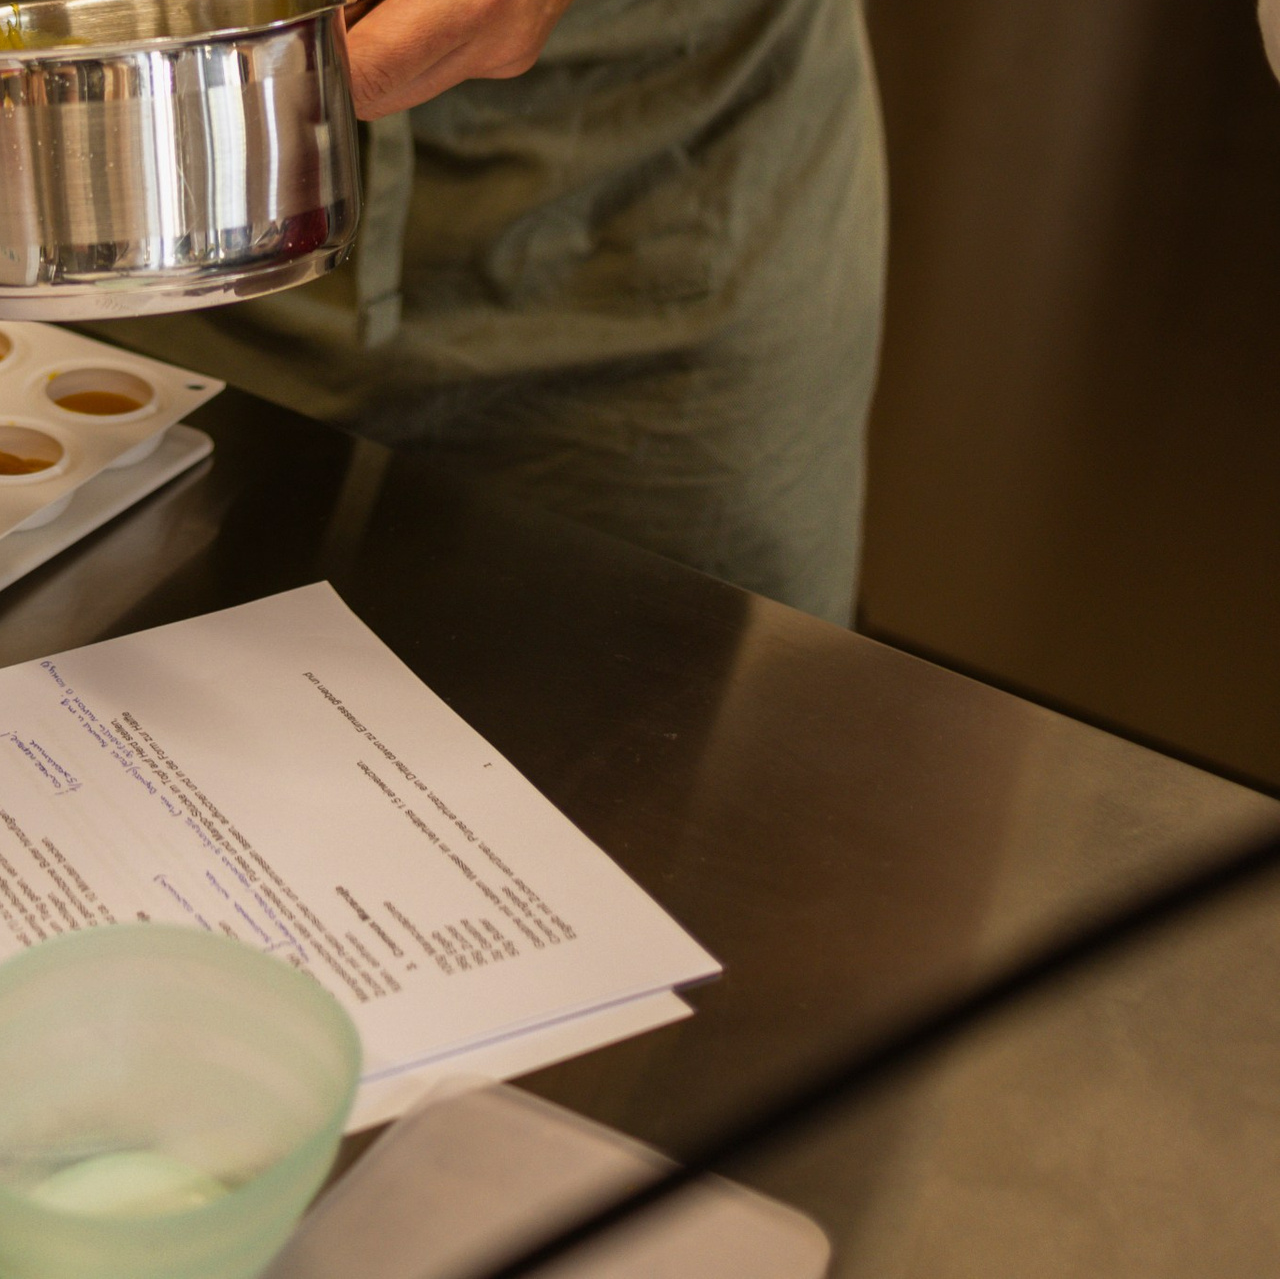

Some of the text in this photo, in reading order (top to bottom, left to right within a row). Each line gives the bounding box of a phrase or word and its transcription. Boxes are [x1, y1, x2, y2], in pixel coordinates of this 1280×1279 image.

[316, 685, 342, 705] geben
[110, 719, 133, 741] stellen,
[121, 711, 141, 731] Hälfte
[336, 705, 367, 732] Eimasse
[128, 741, 147, 758] Herd
[148, 742, 168, 760] Form
[372, 740, 396, 760] davon
[152, 769, 171, 785] Topf
[391, 760, 416, 780] Drittel
[177, 794, 223, 841] Mango-Stücke
[194, 791, 229, 824] aufkochen
[227, 826, 251, 850] lassen,
[404, 809, 439, 843] Verhältnis
[454, 820, 477, 842] Püree
[234, 855, 259, 882] Pürees
[447, 854, 476, 880] Wasser
[477, 842, 513, 876] verrühren,
[475, 880, 501, 905] kaltem
[512, 878, 540, 902] Zucker
